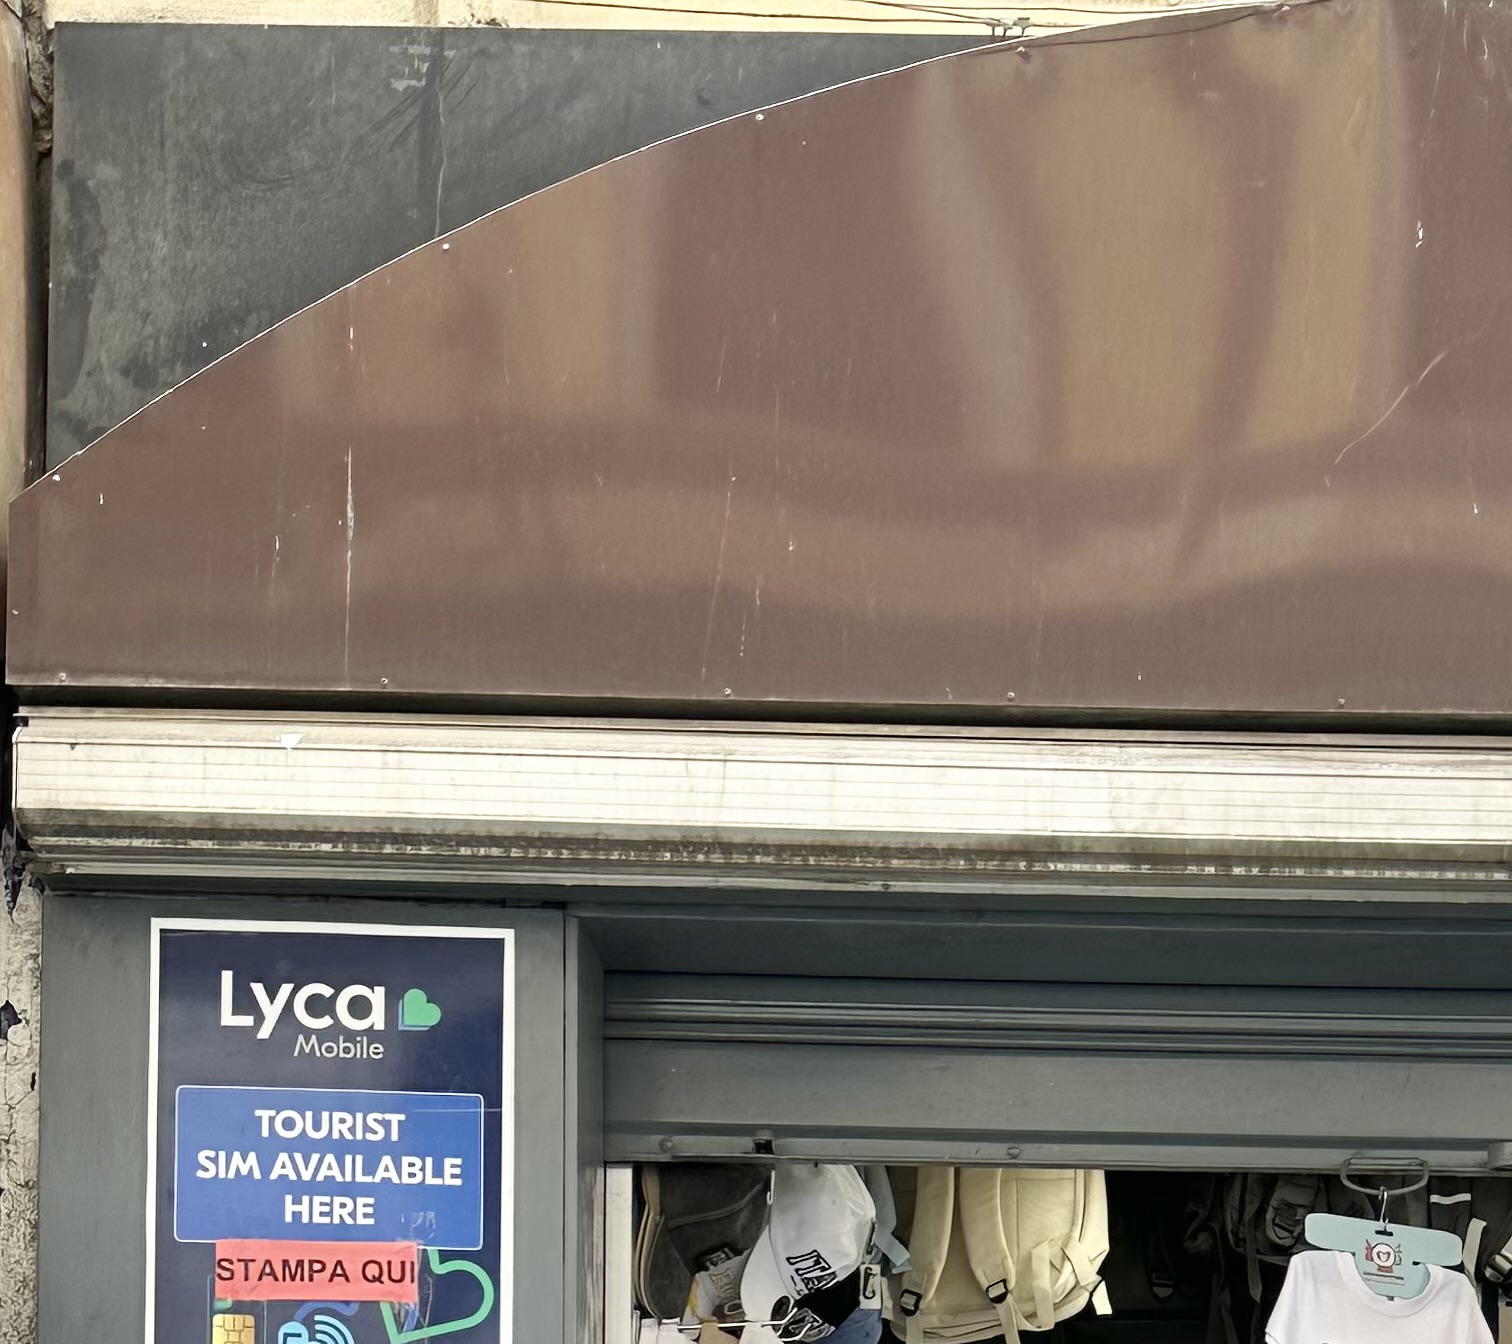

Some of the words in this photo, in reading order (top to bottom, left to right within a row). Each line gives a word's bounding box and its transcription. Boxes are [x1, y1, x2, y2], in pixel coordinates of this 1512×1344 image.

[220, 970, 385, 1039] Lyca
[294, 1034, 384, 1060] Mobile
[255, 1109, 405, 1141] TOURIST
[197, 1151, 264, 1180] SIM
[270, 1153, 461, 1186] AVAILABLE
[284, 1194, 375, 1225] HERE
[216, 1256, 351, 1285] STAMPA
[361, 1260, 417, 1288] QUI
